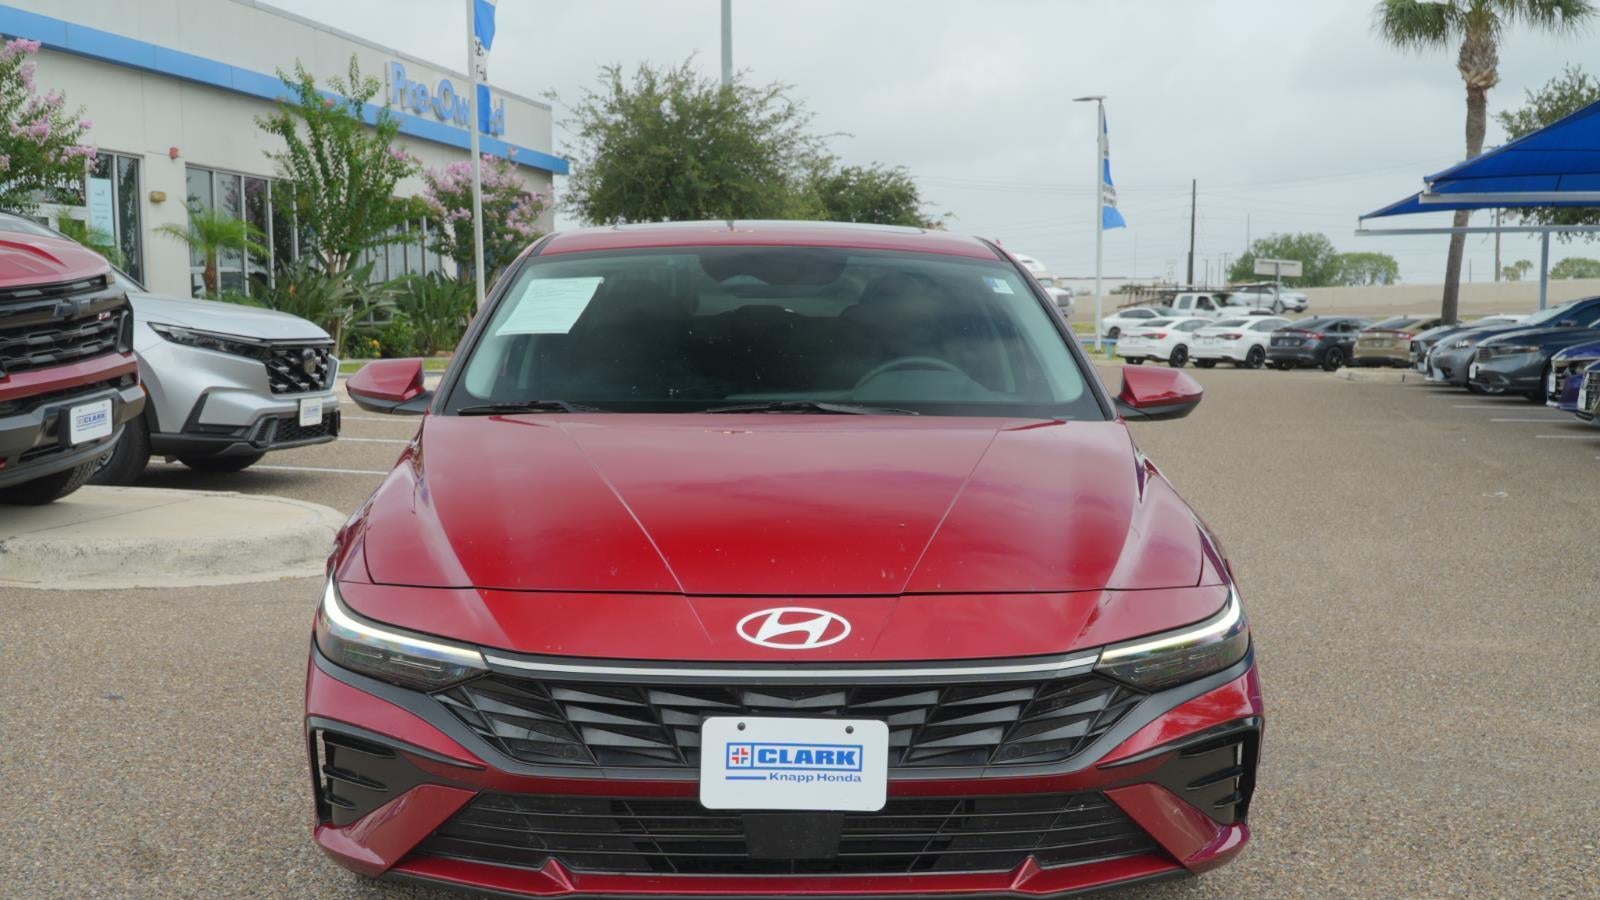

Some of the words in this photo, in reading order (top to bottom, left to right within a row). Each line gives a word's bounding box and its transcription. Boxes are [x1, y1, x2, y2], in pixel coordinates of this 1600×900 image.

[391, 61, 505, 136] Pre-Owd
[757, 749, 856, 766] CLARK
[769, 772, 814, 783] Knapp
[817, 773, 862, 783] Honda
